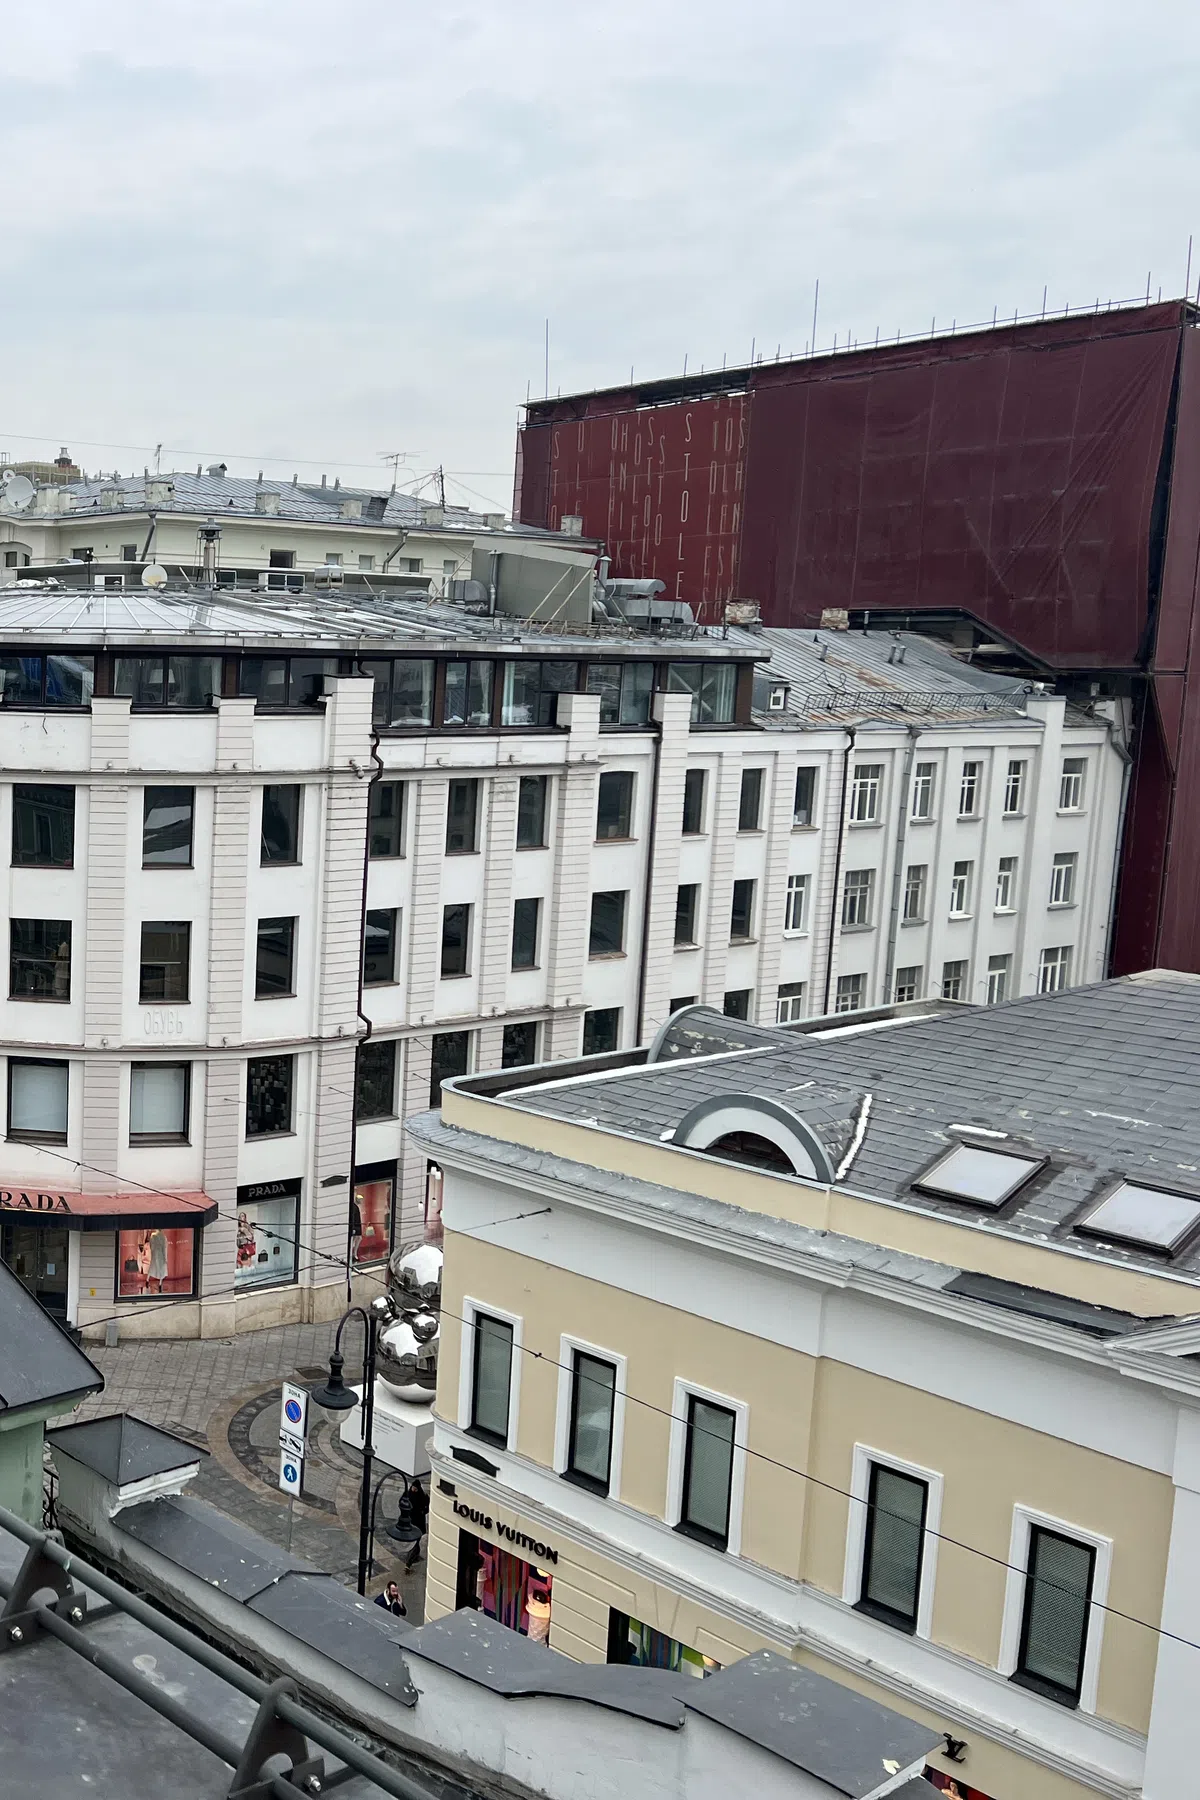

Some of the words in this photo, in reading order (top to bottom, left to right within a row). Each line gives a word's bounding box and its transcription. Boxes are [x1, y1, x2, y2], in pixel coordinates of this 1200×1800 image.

[248, 1184, 286, 1198] PRADA
[453, 1500, 492, 1529] LOUIS
[496, 1521, 558, 1564] VUITTON
